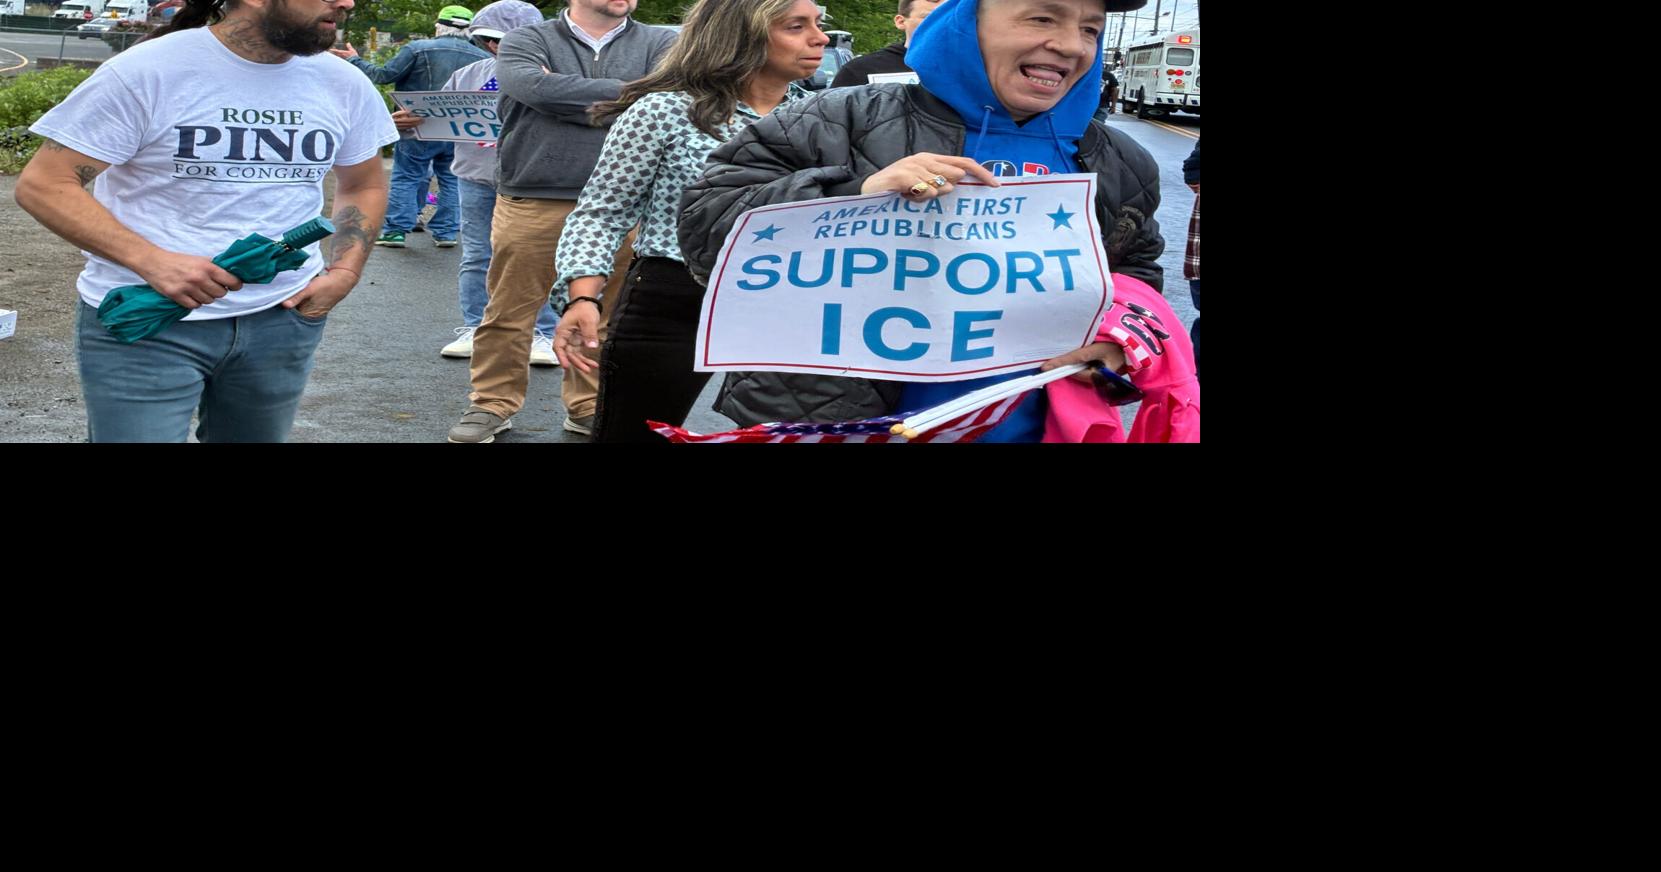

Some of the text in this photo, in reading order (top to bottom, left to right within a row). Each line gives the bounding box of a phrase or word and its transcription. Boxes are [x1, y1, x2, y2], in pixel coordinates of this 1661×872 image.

[220, 107, 305, 126] ROSIE
[410, 107, 496, 120] SUPPO
[173, 125, 335, 163] PINO
[174, 163, 218, 177] FOR
[812, 196, 1028, 224] AMERICA FIRST
[814, 218, 1017, 241] REPUBLICANS
[736, 247, 1082, 295] SUPPORT
[821, 303, 1004, 362] ICE
